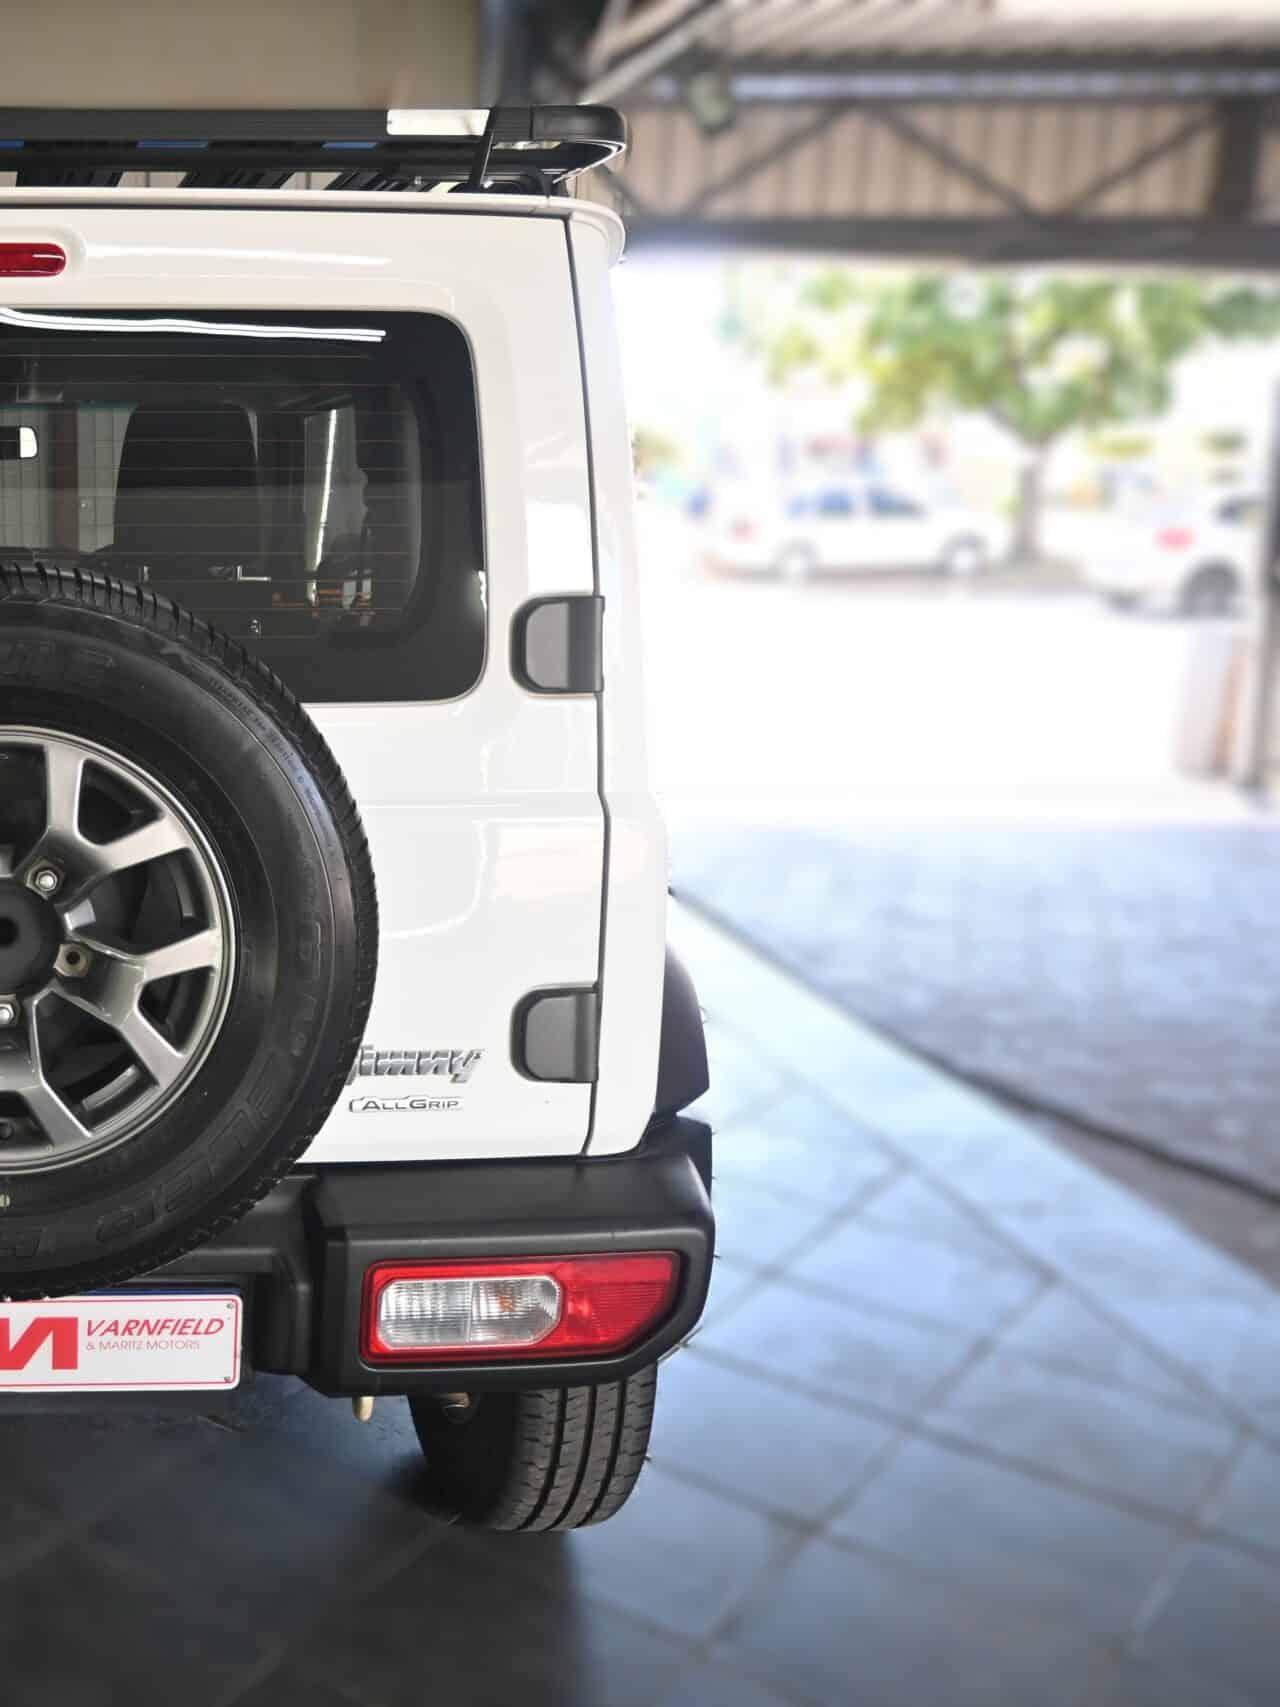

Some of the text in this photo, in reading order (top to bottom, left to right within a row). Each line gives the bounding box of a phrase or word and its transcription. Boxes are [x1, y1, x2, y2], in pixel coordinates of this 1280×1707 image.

[87, 1318, 224, 1336] VARNFIELD
[86, 1339, 201, 1351] & MARITZ MOTORS
